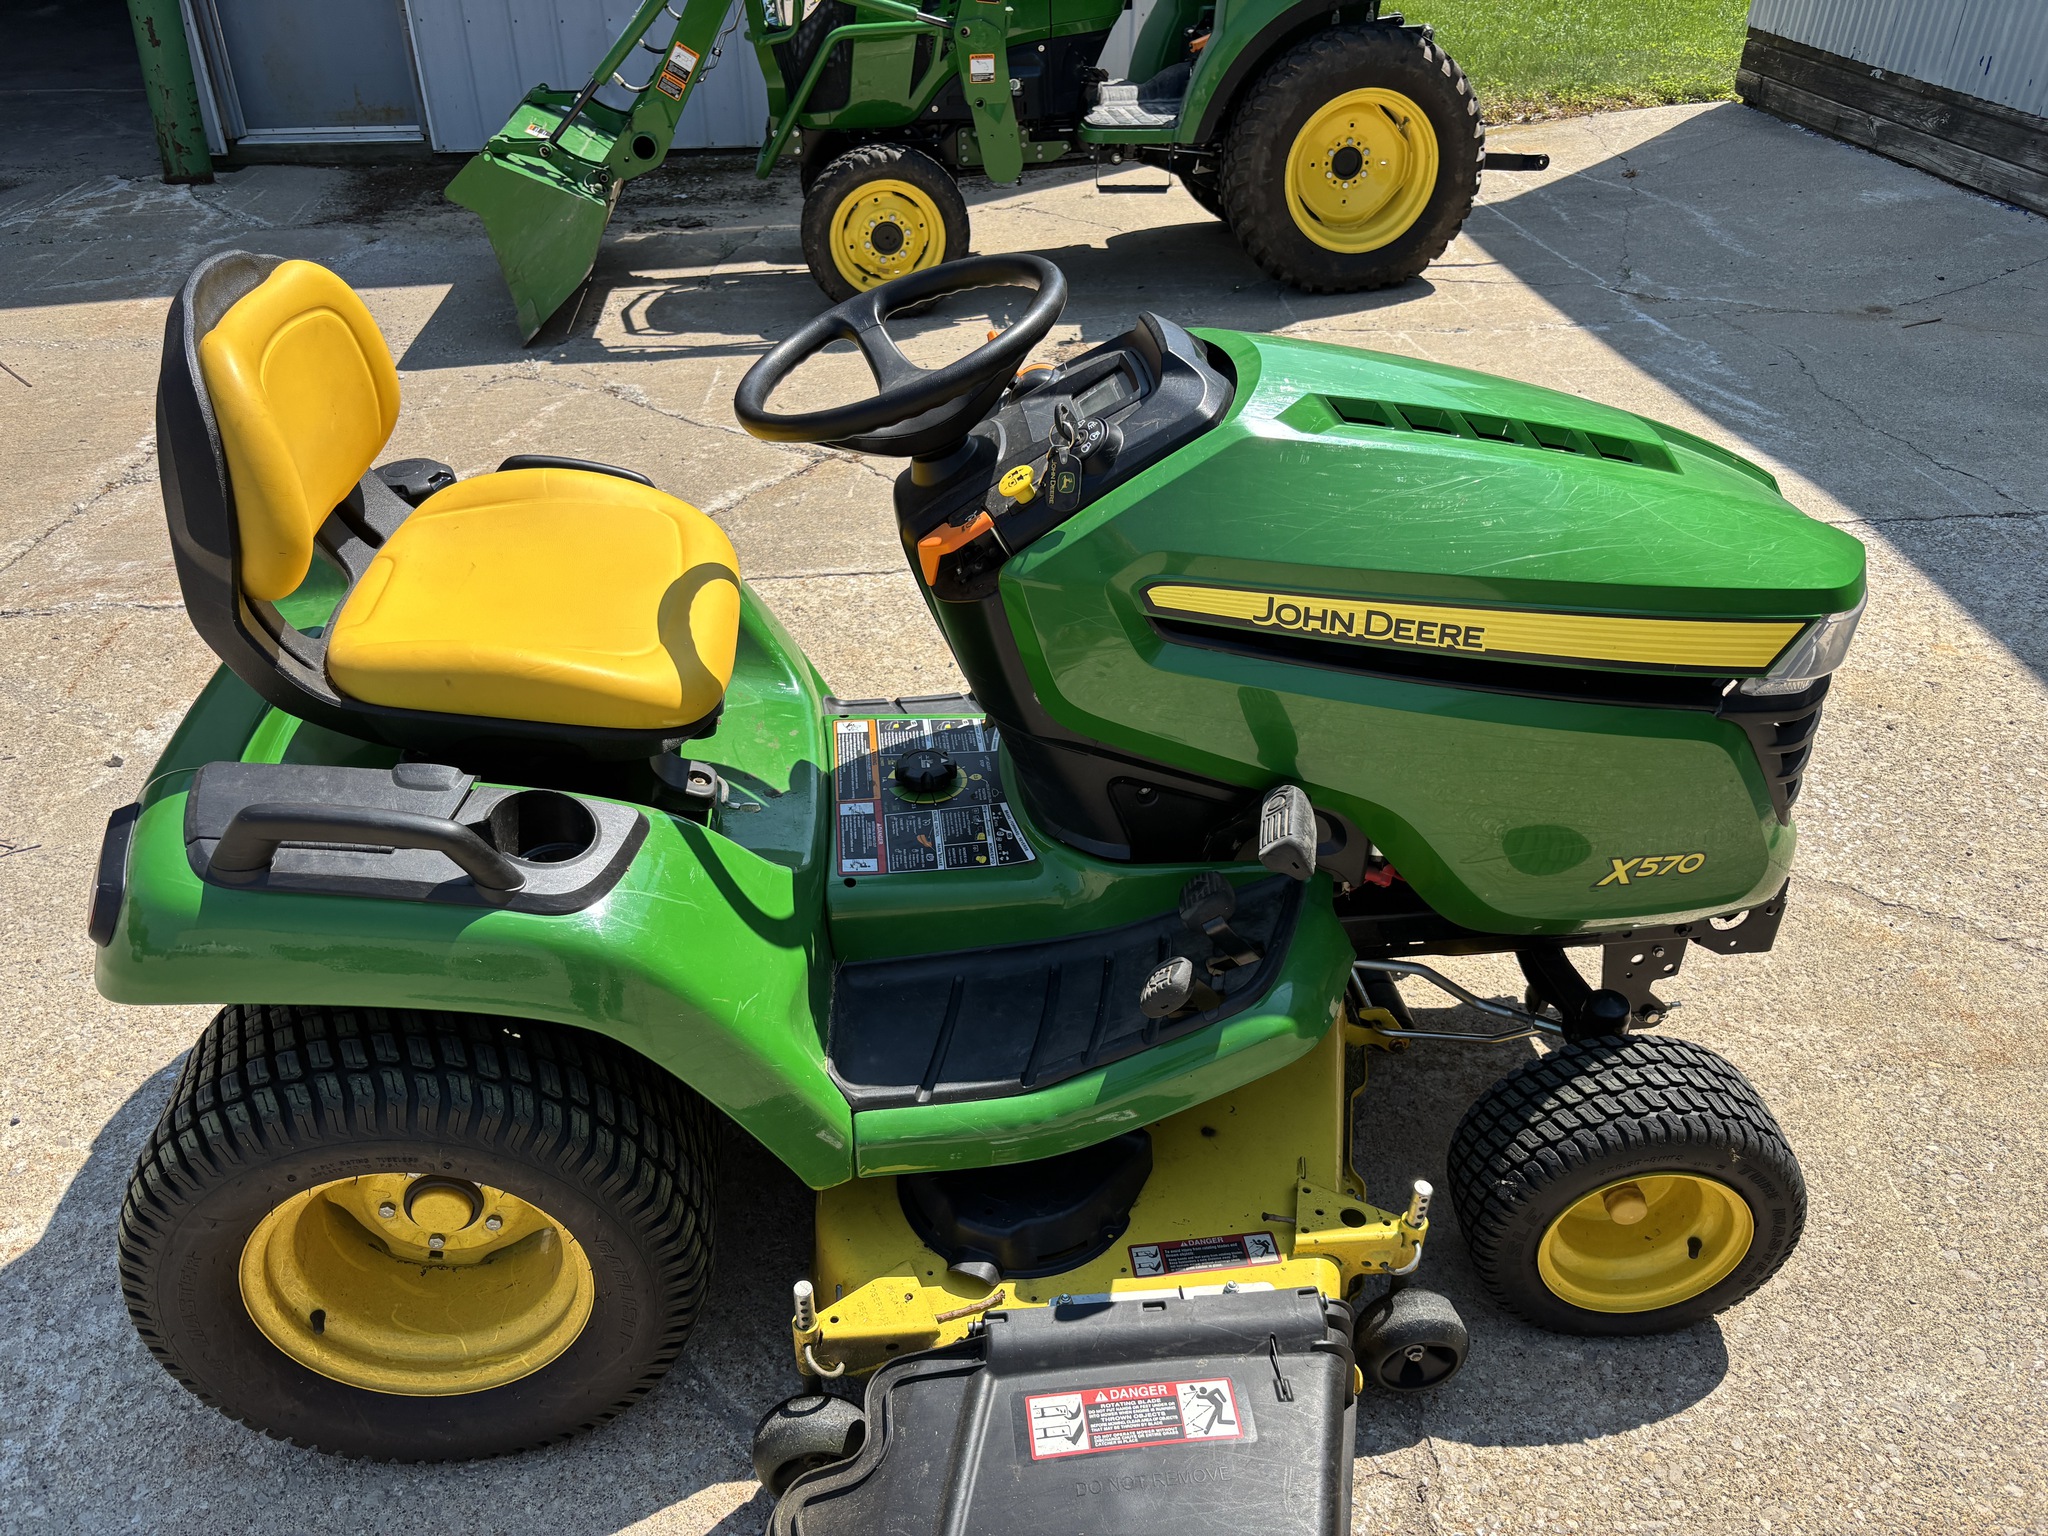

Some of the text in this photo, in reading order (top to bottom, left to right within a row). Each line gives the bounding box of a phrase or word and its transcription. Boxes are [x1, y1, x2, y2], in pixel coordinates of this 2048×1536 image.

[1252, 596, 1486, 649] JOHN DEERE
[1591, 852, 1706, 887] X570
[1188, 1236, 1224, 1246] DANGER
[1737, 1163, 1786, 1287] TURF MASTER
[178, 1251, 210, 1347] MASTER
[1100, 1399, 1136, 1408] ROTATING
[1109, 1384, 1168, 1400] DANGER
[1100, 1410, 1166, 1422] THROWN OBJECTS
[1074, 1465, 1231, 1497] DO NOT REMOVE
